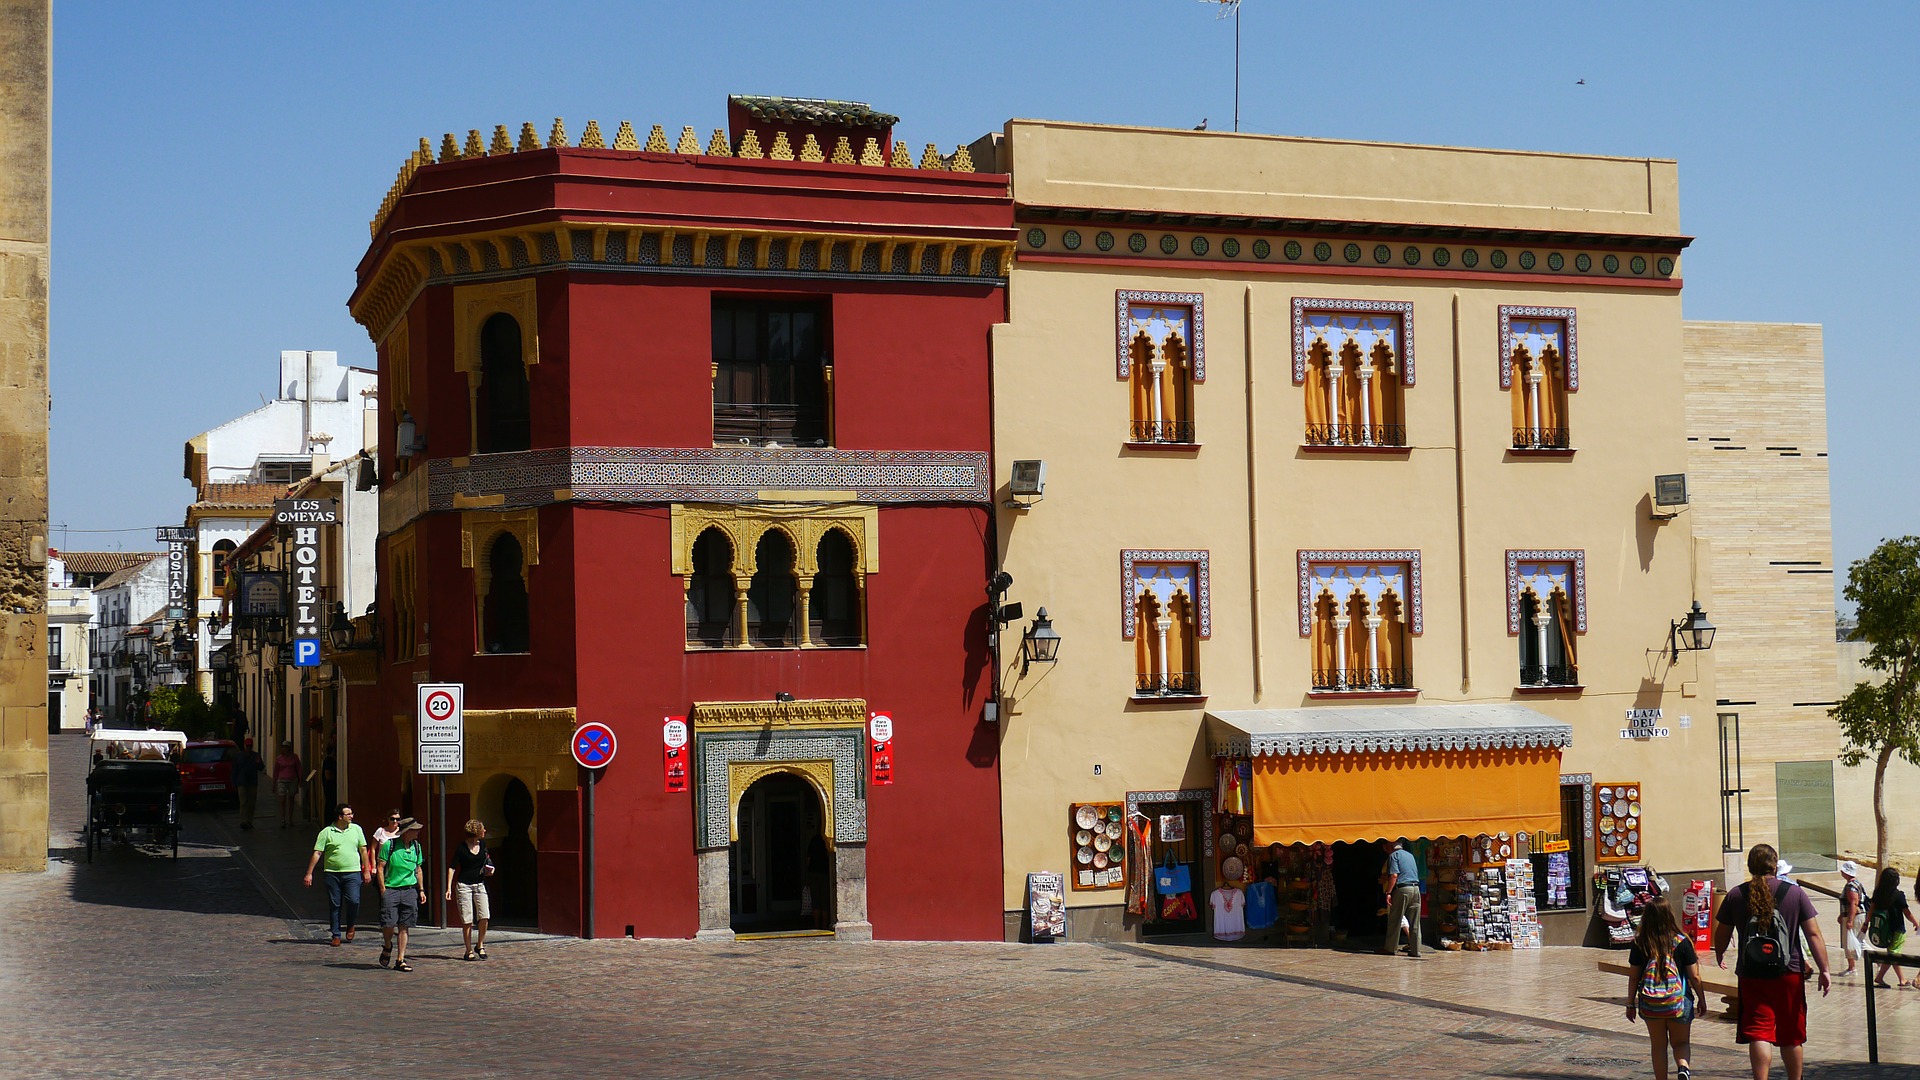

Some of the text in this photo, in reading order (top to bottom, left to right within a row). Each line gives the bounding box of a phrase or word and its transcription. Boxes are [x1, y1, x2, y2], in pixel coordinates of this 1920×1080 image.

[294, 500, 320, 510] LOS
[278, 512, 335, 522] OMEYAS
[158, 528, 166, 539] EL
[170, 542, 182, 599] HOSTAL
[296, 528, 316, 623] HOTEL
[299, 642, 316, 663] P
[432, 701, 448, 710] 20
[1626, 709, 1662, 718] PLAZA
[1633, 719, 1654, 727] DEL
[1621, 728, 1668, 738] TRIUNFO
